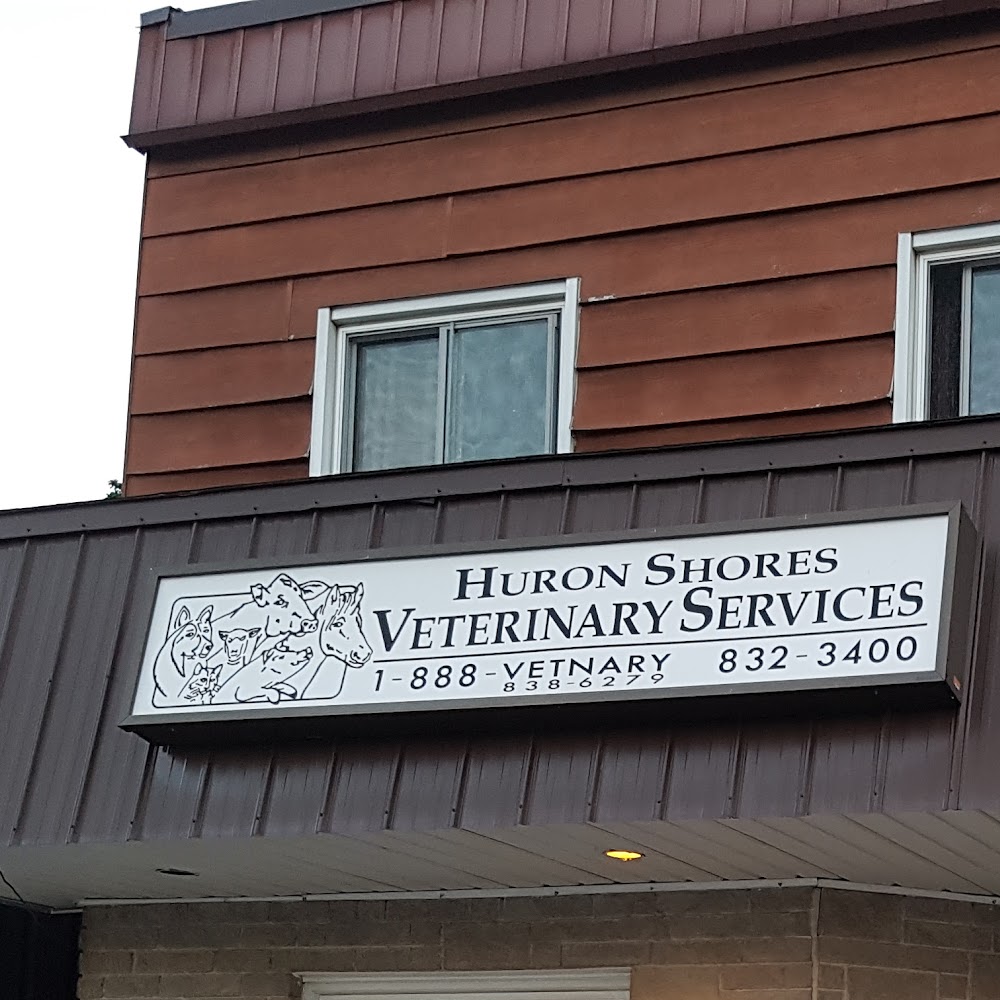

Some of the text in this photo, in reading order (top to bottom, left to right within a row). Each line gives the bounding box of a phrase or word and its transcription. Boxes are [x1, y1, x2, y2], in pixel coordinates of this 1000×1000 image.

[453, 548, 839, 600] HURON SHORES
[373, 580, 924, 652] VETERINARY SERVICES
[719, 636, 918, 674] 832-3400
[503, 673, 664, 692] 838-6279
